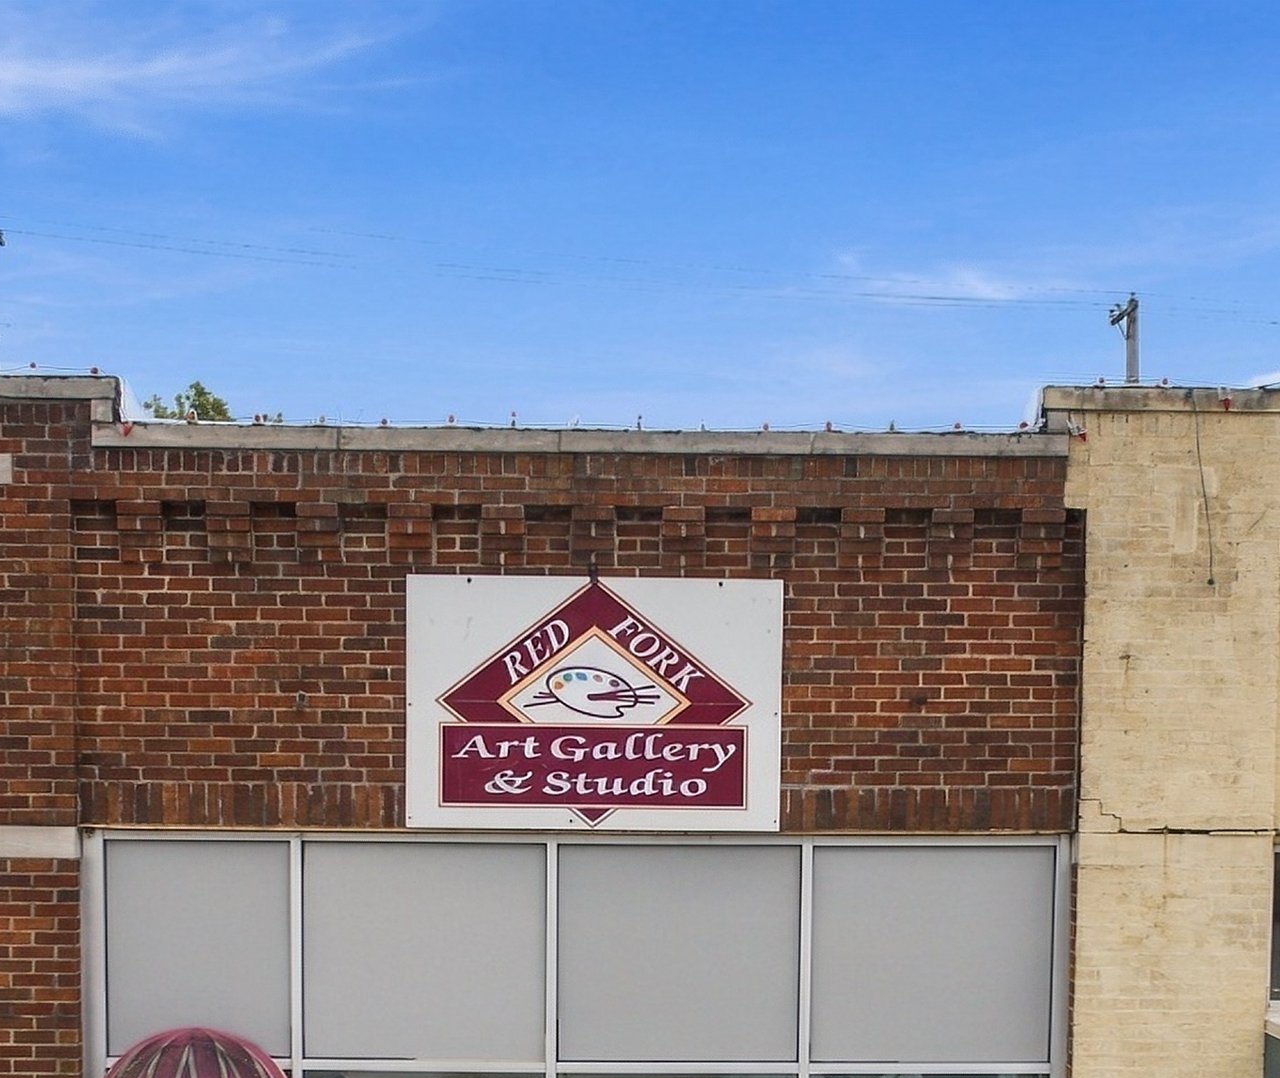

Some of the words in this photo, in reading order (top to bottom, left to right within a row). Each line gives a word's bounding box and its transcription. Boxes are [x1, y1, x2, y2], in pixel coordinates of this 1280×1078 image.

[501, 619, 571, 685] RED
[607, 615, 706, 693] FORK
[451, 734, 542, 760] Art
[550, 732, 737, 772] Gallery
[484, 770, 534, 794] &
[542, 768, 708, 797] Studio
